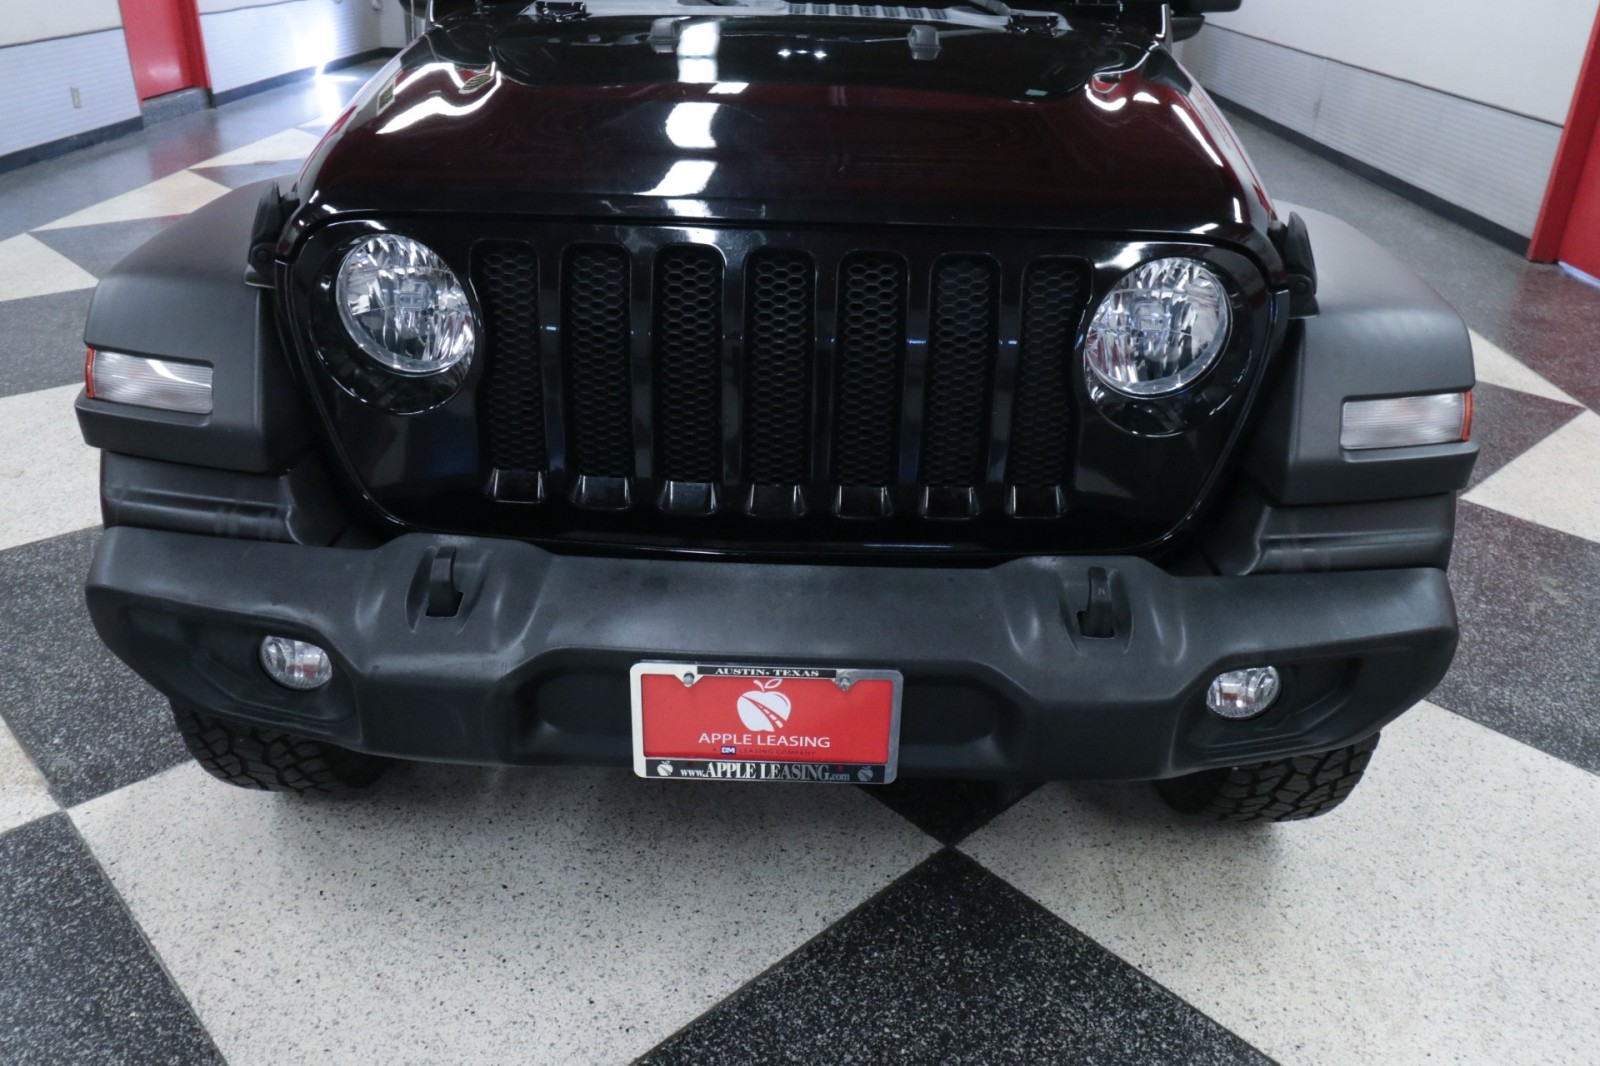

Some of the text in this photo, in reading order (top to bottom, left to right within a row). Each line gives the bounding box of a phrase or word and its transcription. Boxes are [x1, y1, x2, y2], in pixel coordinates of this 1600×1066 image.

[773, 669, 820, 677] TEXAS
[698, 732, 831, 748] APPLE LEASING
